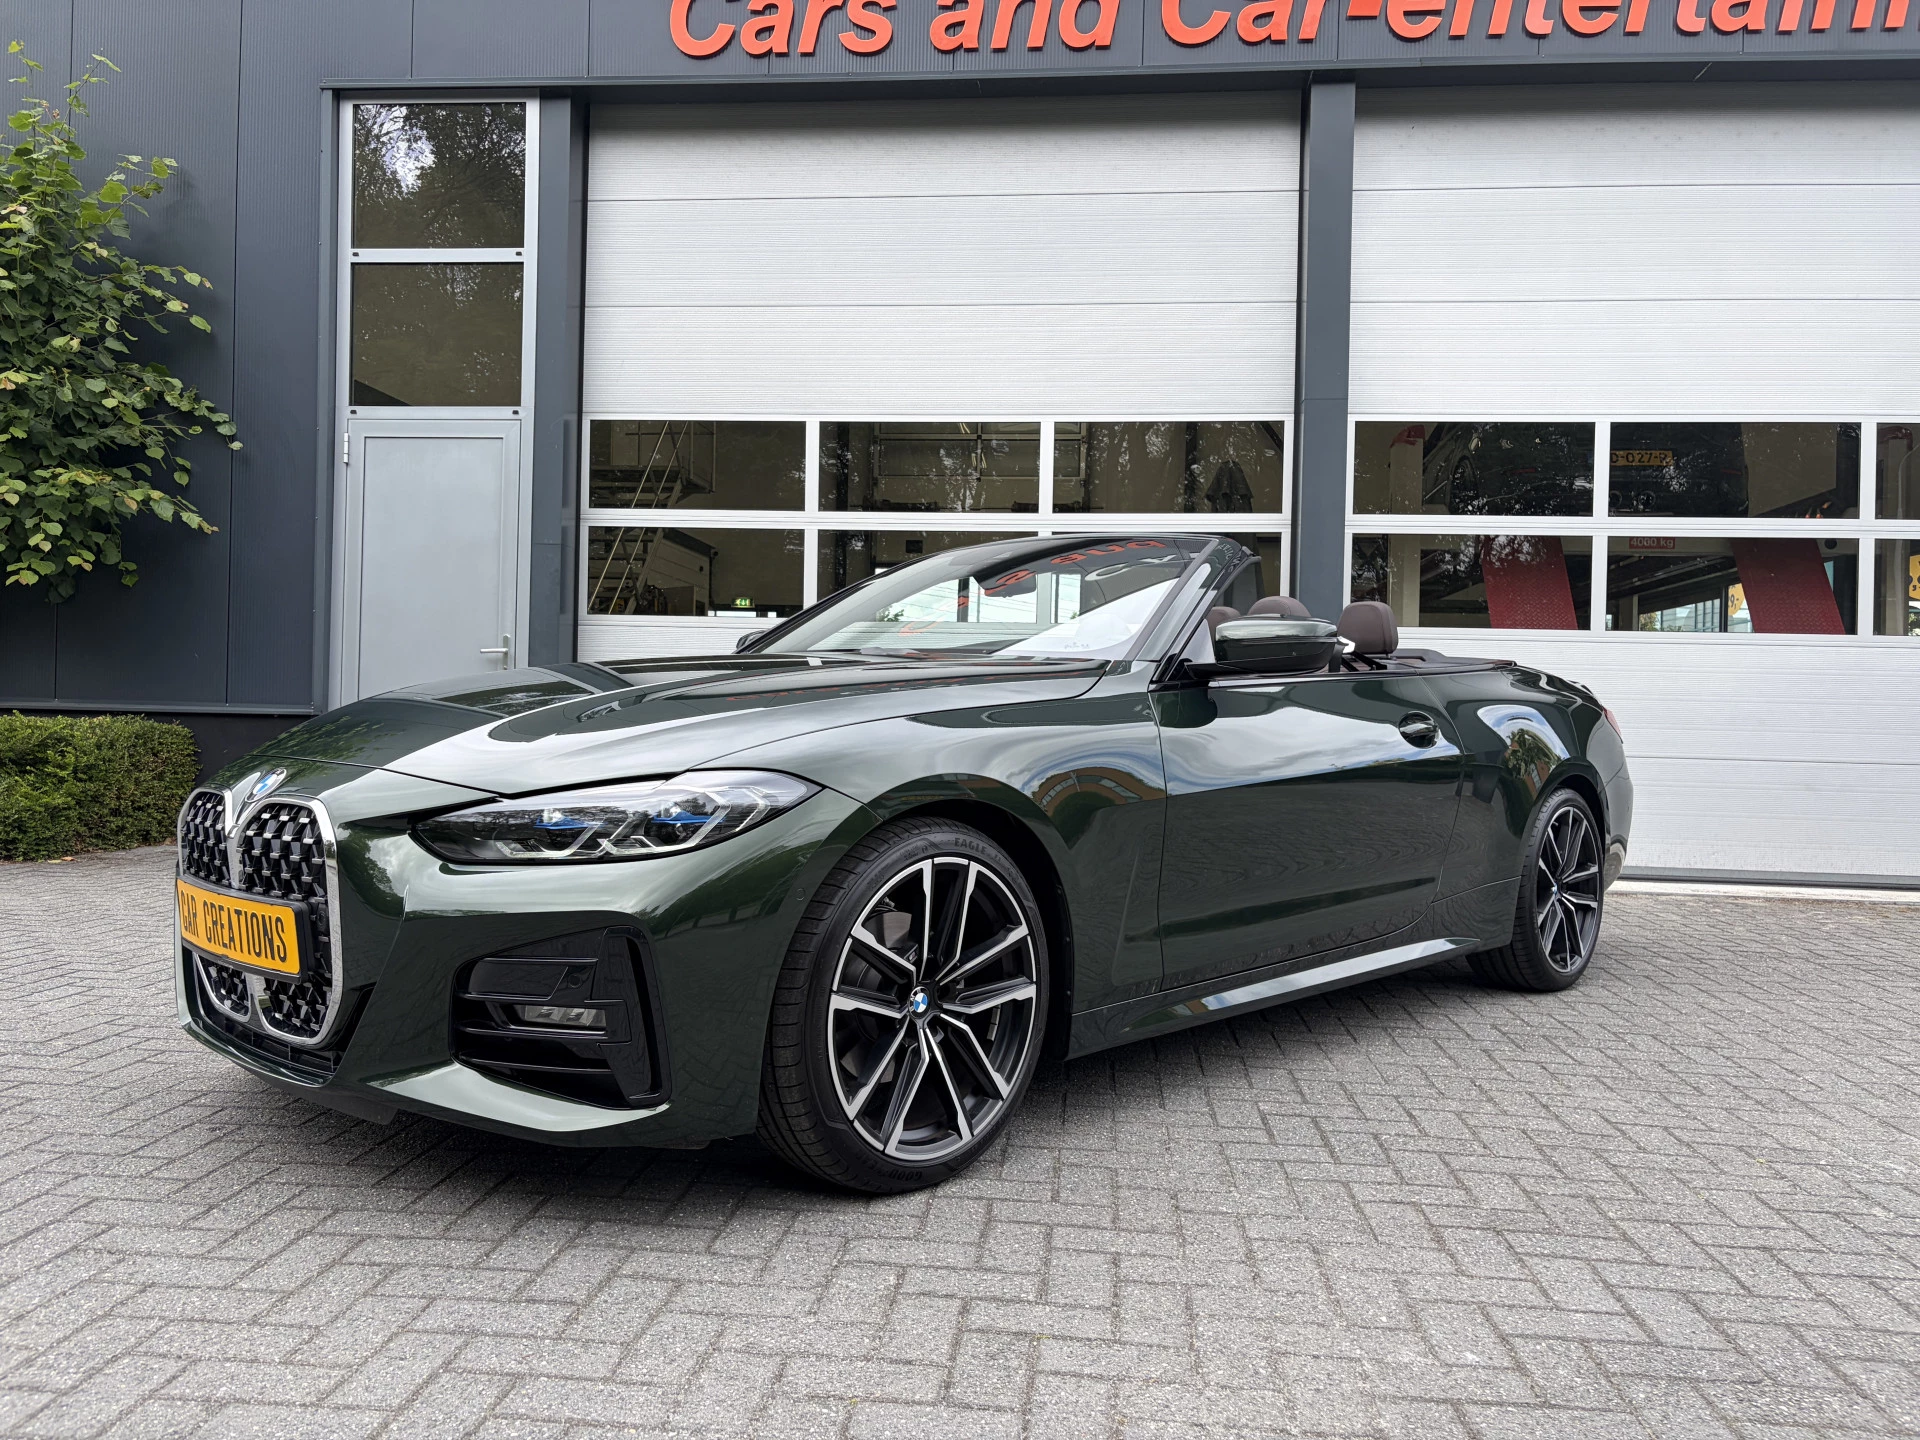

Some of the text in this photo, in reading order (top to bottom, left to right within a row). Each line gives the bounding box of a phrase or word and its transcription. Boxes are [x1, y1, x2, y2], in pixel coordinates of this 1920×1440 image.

[669, 0, 897, 56] Cars
[929, 0, 1121, 51] and
[1630, 537, 1674, 549] 4000 kg
[954, 838, 988, 856] EAGLE
[181, 890, 287, 963] CAR CREATIONS
